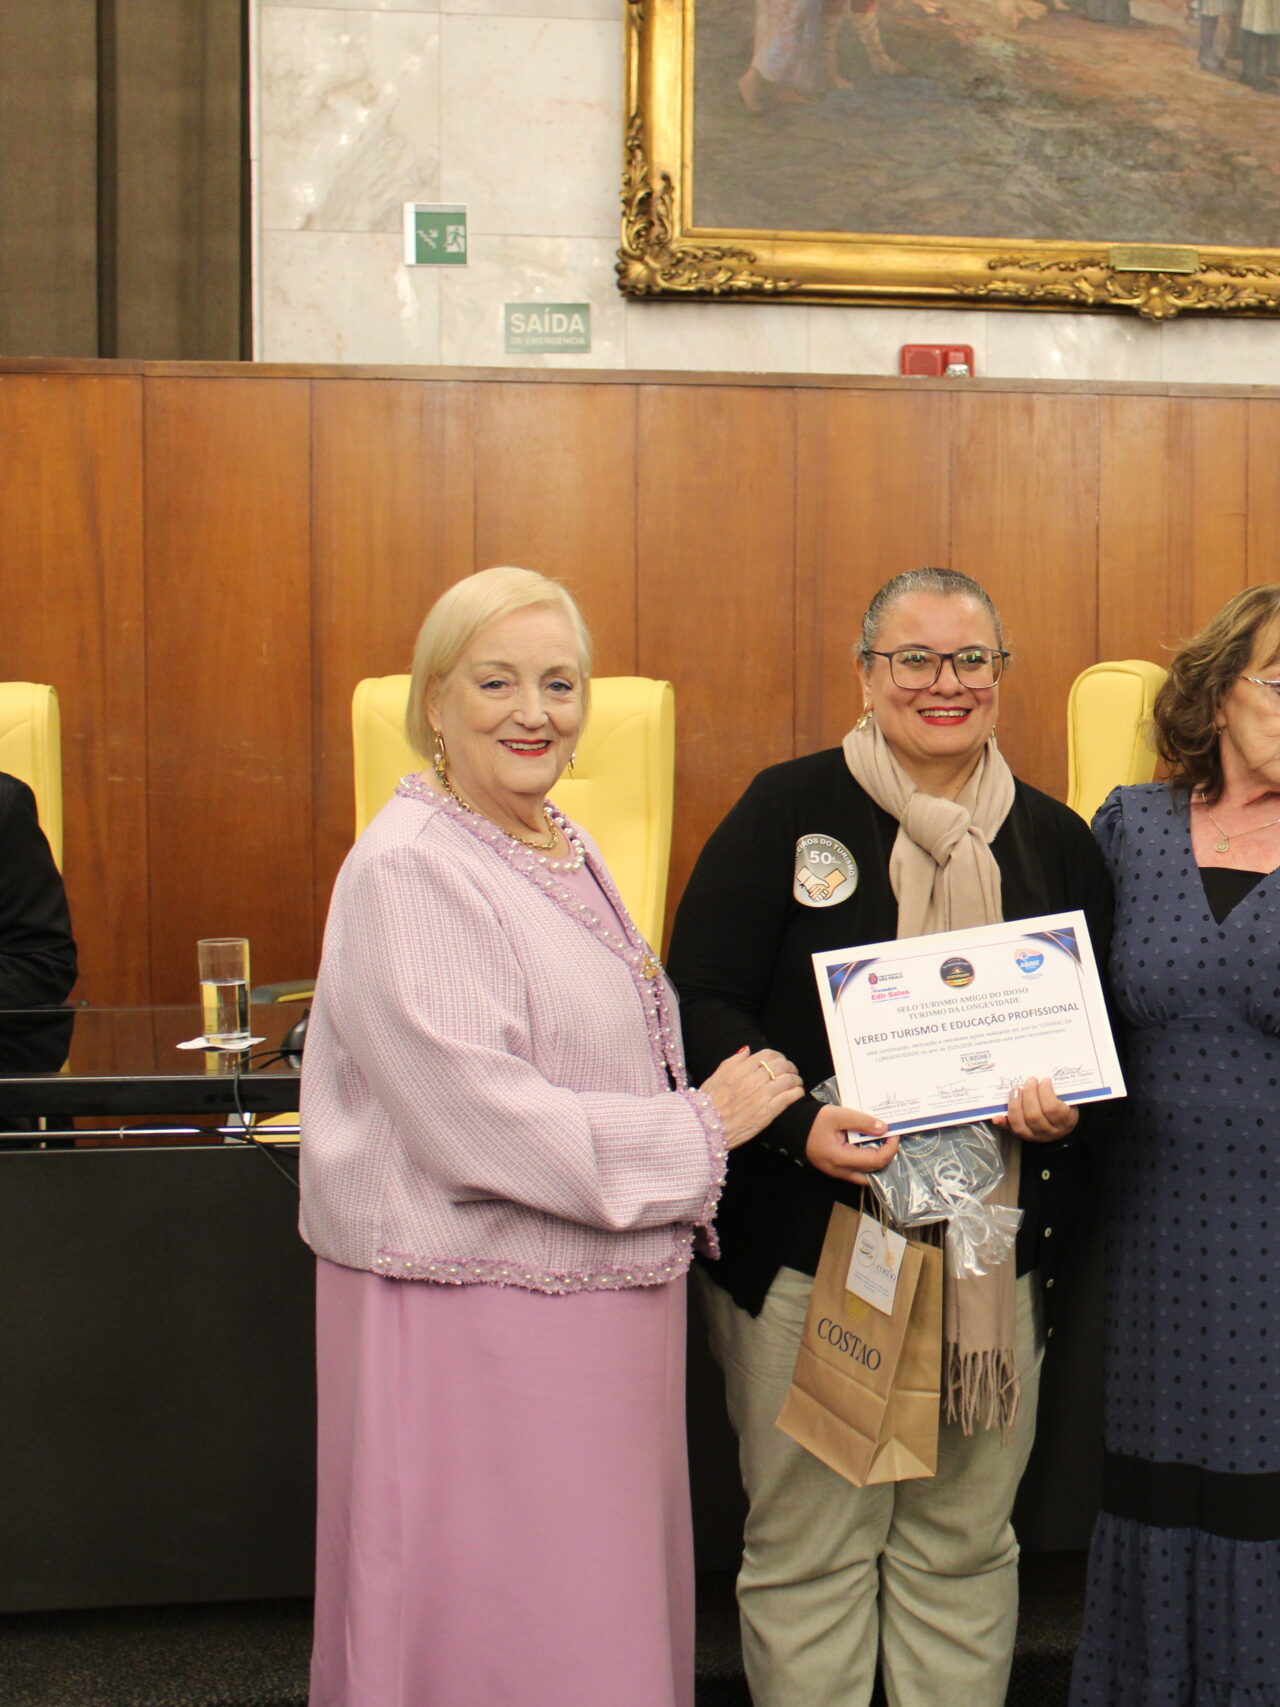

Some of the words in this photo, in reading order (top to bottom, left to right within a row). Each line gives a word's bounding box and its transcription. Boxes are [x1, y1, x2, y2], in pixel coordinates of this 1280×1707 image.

[510, 307, 586, 333] SAÍDA
[820, 839, 832, 847] DO
[833, 844, 855, 877] TURISMO
[910, 1008, 946, 1020] TURISMO
[949, 1006, 961, 1014] DA
[961, 997, 1020, 1012] LONGEVIDADE
[920, 997, 958, 1009] TURISMO
[959, 993, 988, 1003] AMIGO
[1004, 987, 1029, 996] IDOSO
[854, 1033, 888, 1046] VERED
[890, 1024, 939, 1040] TURISMO
[942, 1023, 948, 1031] E
[950, 1013, 1006, 1031] EDUCAÇÃO
[1008, 1002, 1079, 1021] PROFISSIONAL
